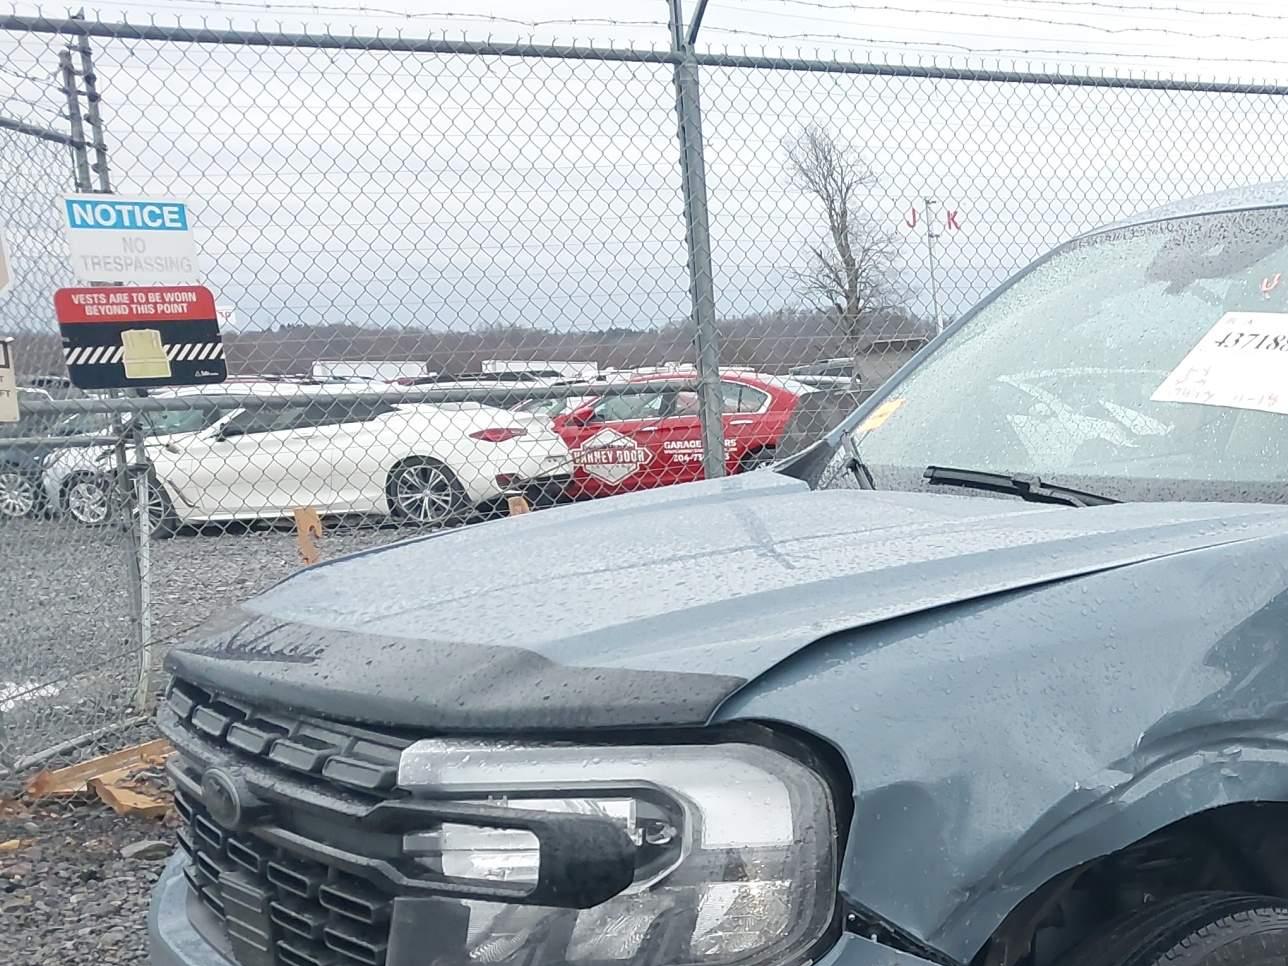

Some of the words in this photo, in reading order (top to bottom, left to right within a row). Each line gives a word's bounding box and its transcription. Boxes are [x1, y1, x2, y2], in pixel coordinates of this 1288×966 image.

[72, 203, 183, 228] NOTICE
[907, 208, 917, 229] J
[946, 210, 961, 230] K
[121, 237, 146, 254] NO
[80, 255, 193, 273] TRESPASSING
[72, 294, 107, 305] VESTS
[109, 293, 129, 304] ARE
[132, 292, 146, 303] TO
[148, 292, 162, 303] BE
[164, 291, 197, 303] WORN
[85, 304, 129, 316] BEYOND
[131, 304, 156, 315] THIS
[157, 302, 188, 314] POINT
[663, 440, 702, 449] GARAGE
